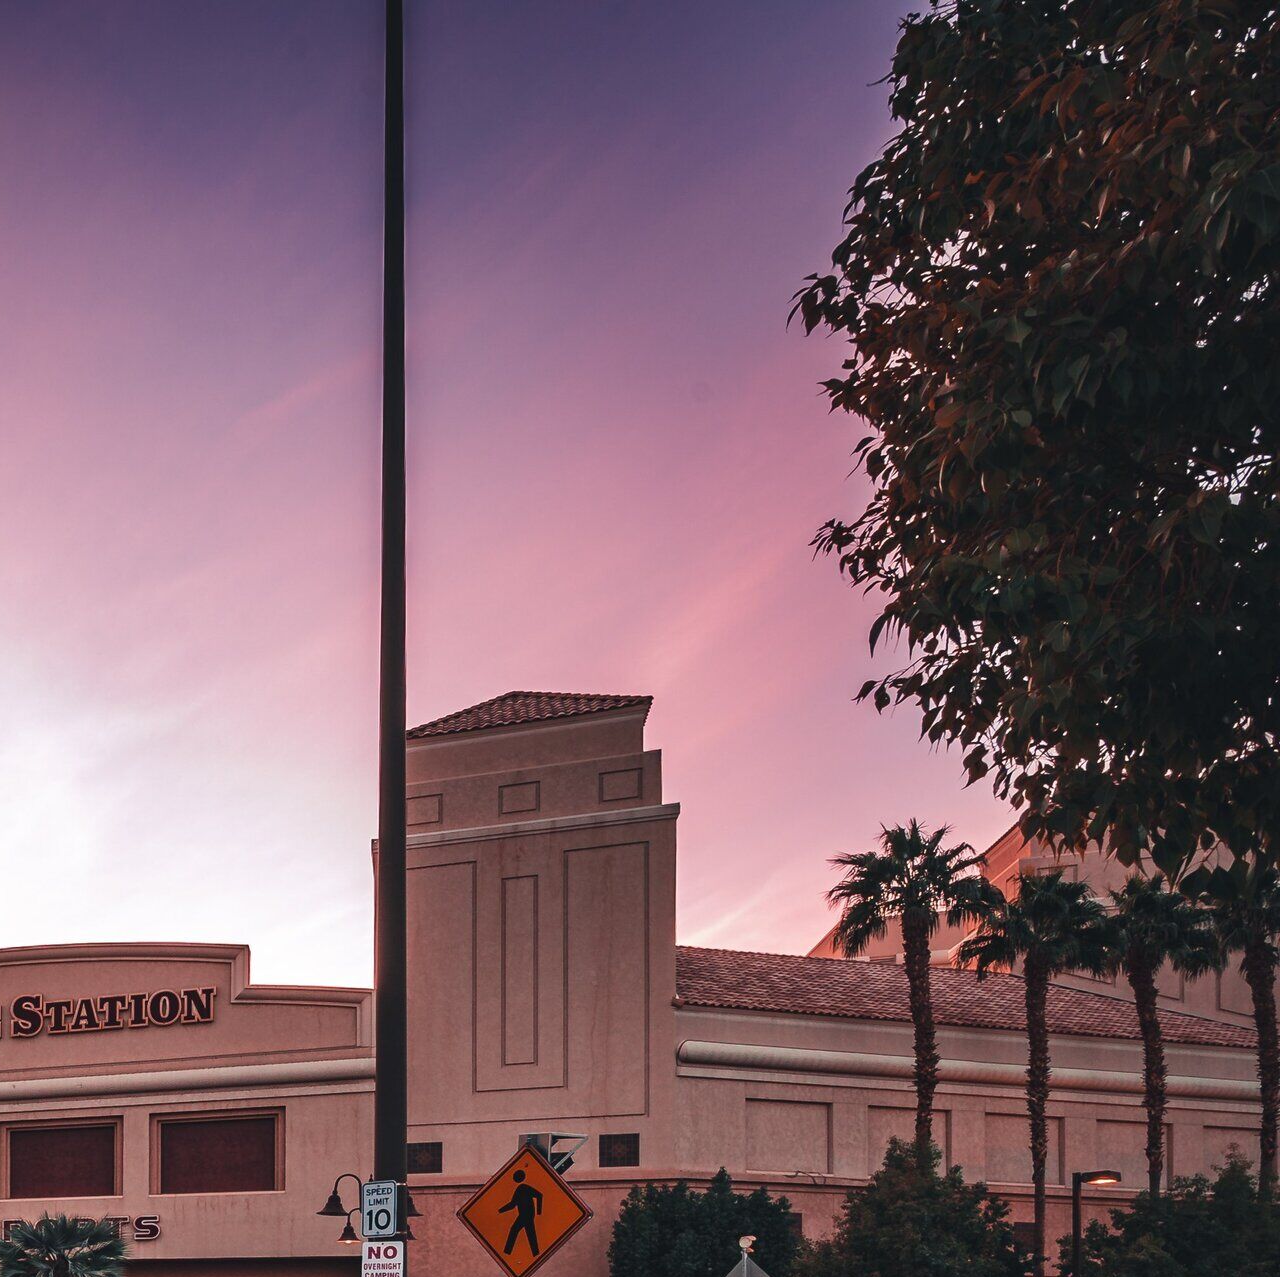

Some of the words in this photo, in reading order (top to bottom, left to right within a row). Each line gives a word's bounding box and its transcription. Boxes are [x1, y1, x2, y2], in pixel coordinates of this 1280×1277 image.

[10, 986, 217, 1038] STATION
[365, 1187, 393, 1197] SPEED
[368, 1198, 390, 1206] LIMIT
[366, 1208, 391, 1231] 10
[367, 1245, 398, 1260] NO
[363, 1262, 402, 1271] OVERNIGHT
